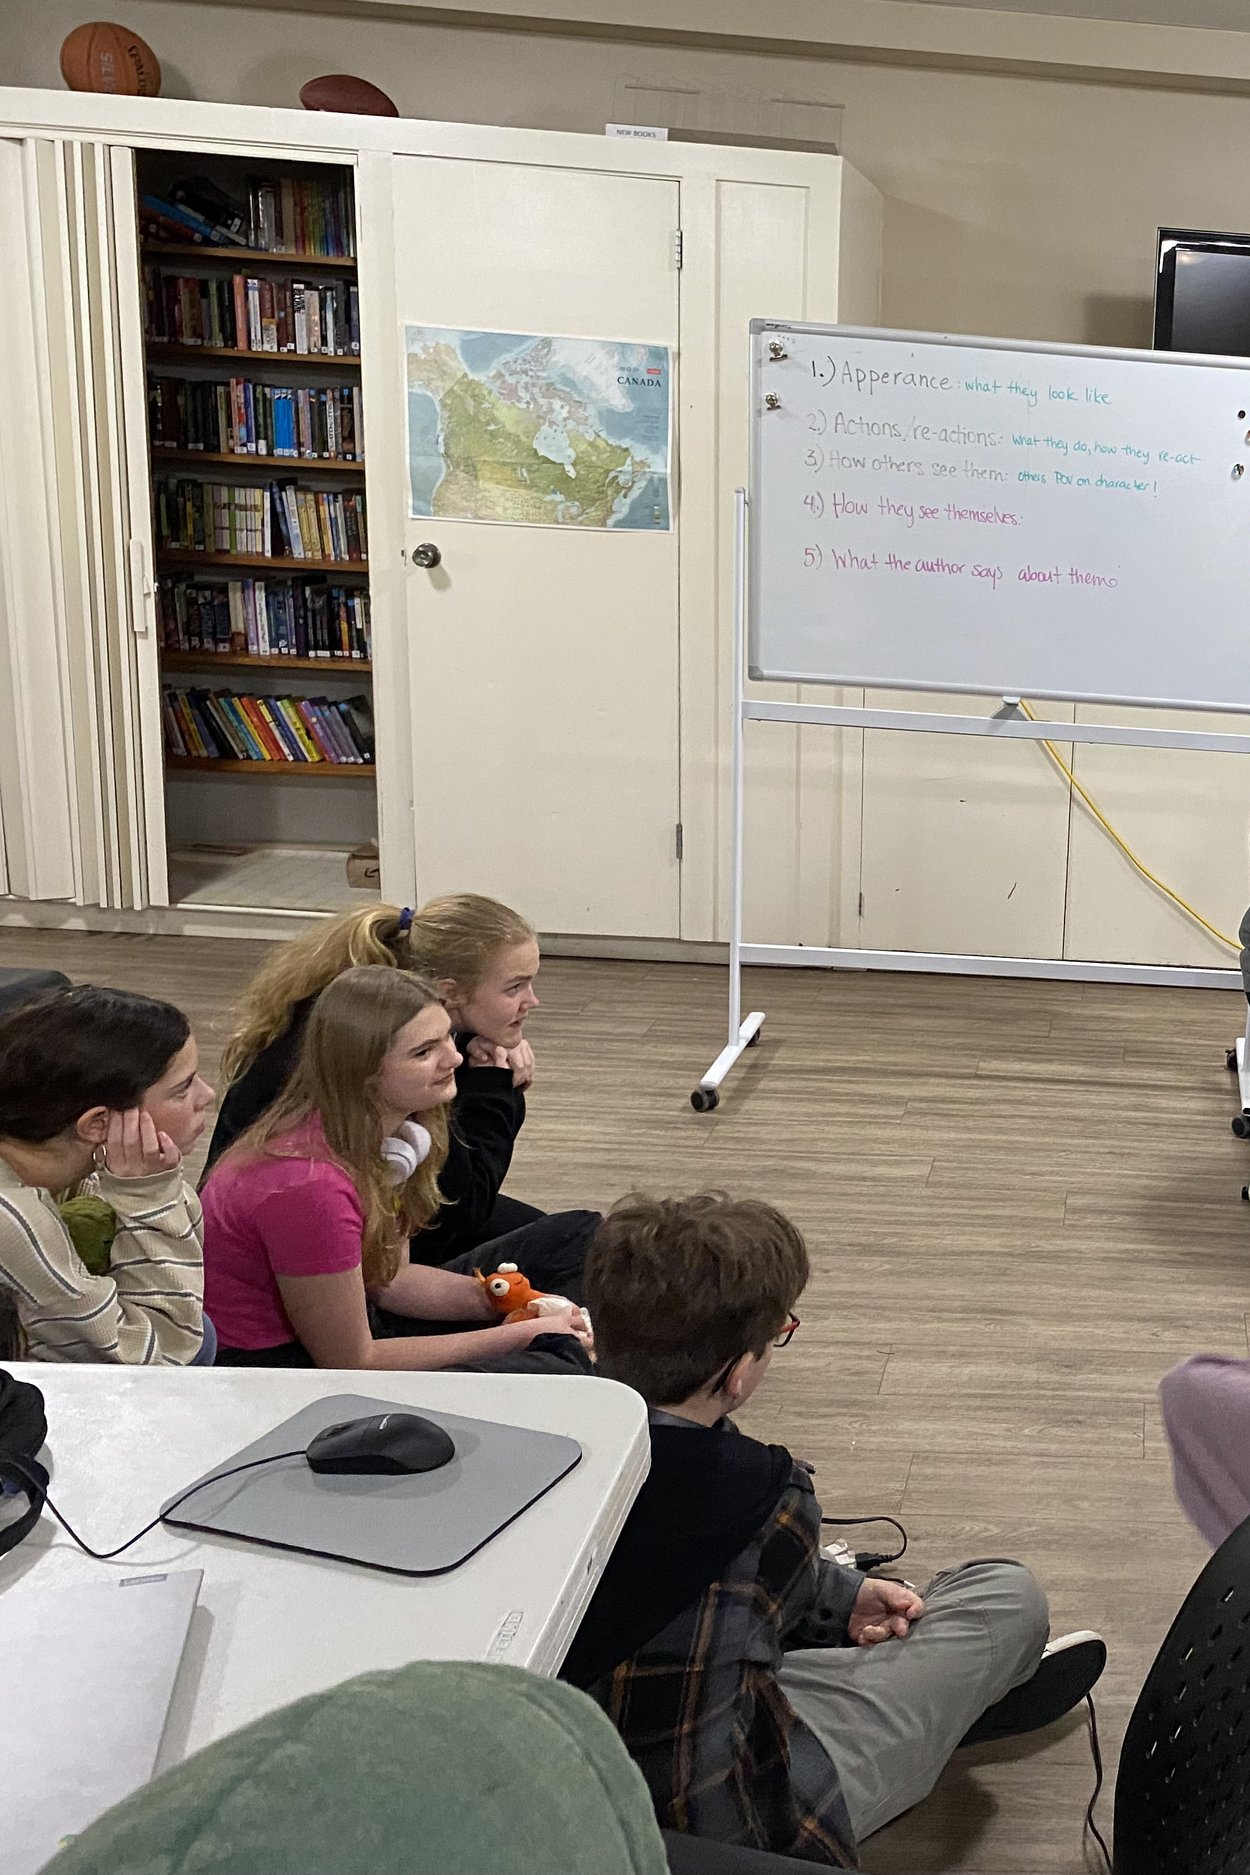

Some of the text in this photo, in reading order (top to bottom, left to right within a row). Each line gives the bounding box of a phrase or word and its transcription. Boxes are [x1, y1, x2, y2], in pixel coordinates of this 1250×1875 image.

[616, 129, 656, 139] NEW BOOKS
[617, 376, 662, 388] CANADA
[811, 355, 836, 387] 1.)
[965, 376, 1002, 394] what
[1007, 380, 1038, 408] they
[1048, 384, 1079, 401] look
[1085, 387, 1113, 405] like
[805, 409, 828, 436] 2.)
[1012, 434, 1041, 447] what
[1043, 435, 1069, 456] they
[1094, 441, 1117, 455] how
[1121, 444, 1150, 465] they
[1158, 450, 1201, 465] re-act
[829, 449, 866, 469] How
[872, 454, 925, 476] others
[931, 461, 957, 477] see
[963, 459, 1009, 482] them:
[1054, 471, 1073, 485] POV
[1077, 478, 1090, 487] on
[833, 492, 868, 518] How
[877, 496, 915, 529] they
[918, 504, 940, 520] see
[944, 503, 1024, 526] themselves:
[832, 548, 879, 569] What
[885, 553, 910, 571] the
[915, 557, 966, 575] author
[971, 564, 1004, 590] says
[1018, 565, 1062, 584] about
